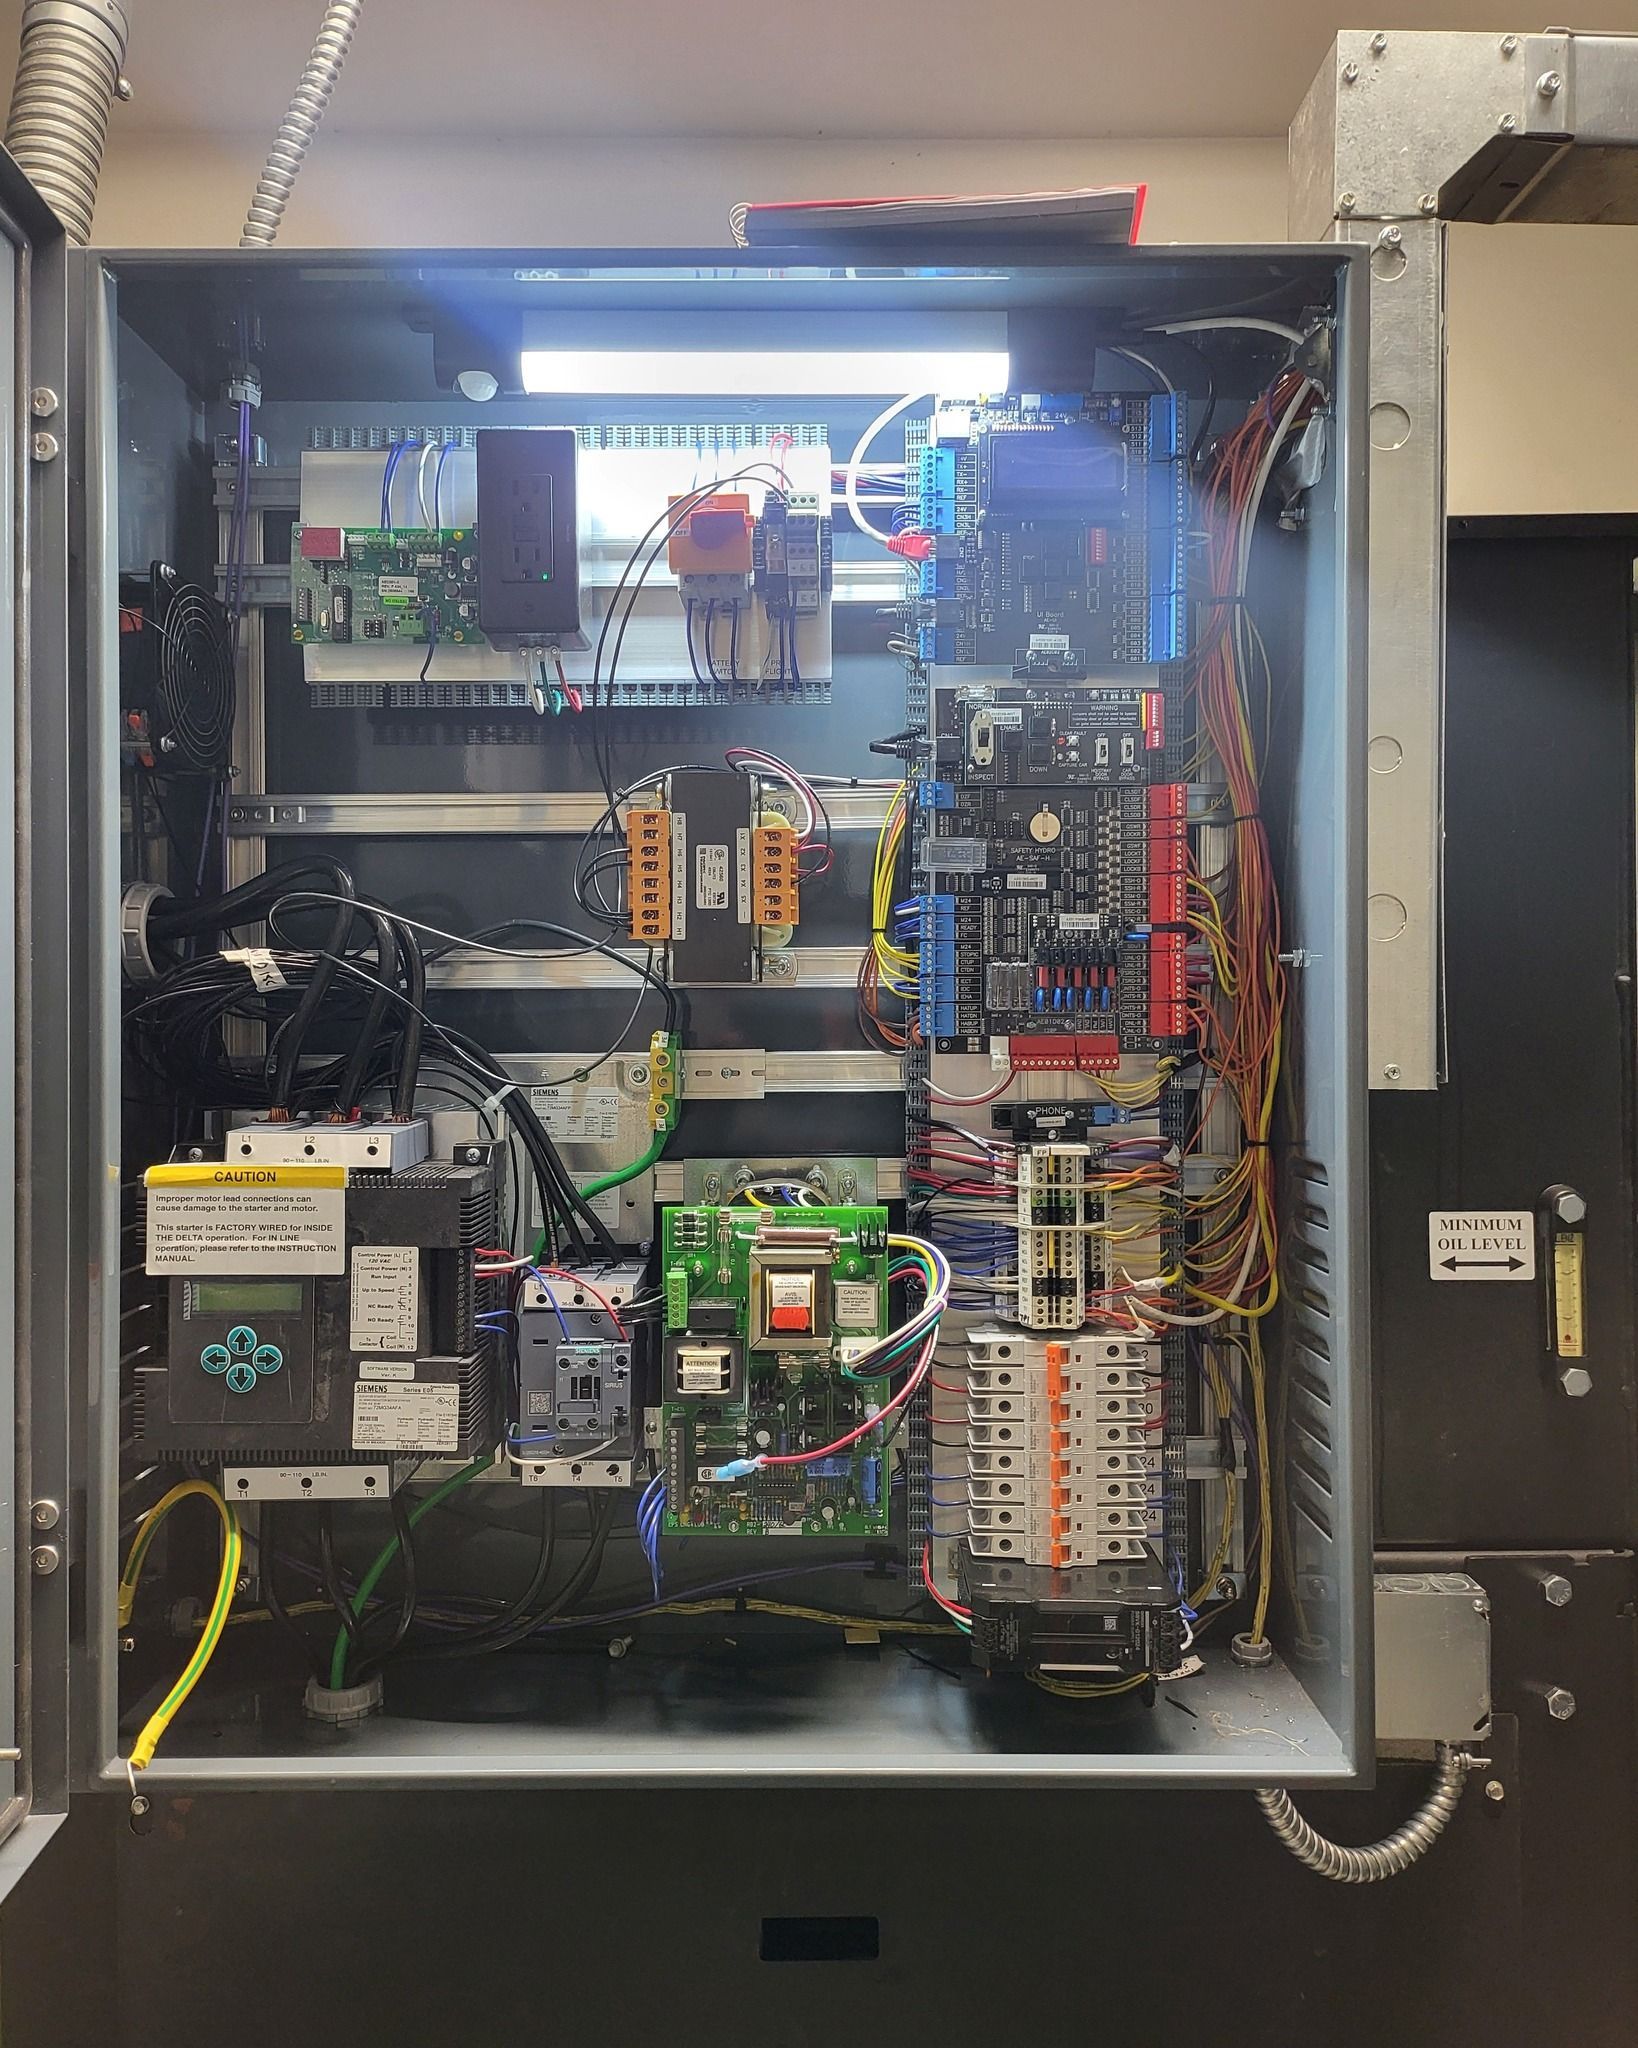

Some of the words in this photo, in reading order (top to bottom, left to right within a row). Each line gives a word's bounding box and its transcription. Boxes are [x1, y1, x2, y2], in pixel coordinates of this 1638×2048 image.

[677, 817, 682, 826] H8
[678, 833, 682, 841] H7
[740, 832, 745, 840] X1
[678, 848, 682, 857] H6
[740, 848, 745, 856] X2
[677, 864, 682, 873] H5
[741, 864, 746, 872] X3
[677, 880, 682, 888] H4
[677, 896, 682, 904] H3
[741, 895, 746, 904] X5
[677, 912, 682, 920] H2
[677, 927, 682, 935] H1
[1035, 1106, 1066, 1115] PHONE
[214, 1171, 276, 1182] CAUTION
[156, 1195, 194, 1203] Improper
[183, 1204, 216, 1213] damage
[1440, 1219, 1522, 1230] MINIMUM
[205, 1234, 248, 1242] operation.
[1438, 1238, 1467, 1250] OIL
[1472, 1238, 1526, 1250] LEVEL
[155, 1245, 197, 1253] operation,
[200, 1244, 227, 1252] please
[277, 1244, 337, 1252] INSTRUCTION
[357, 1384, 388, 1393] SIEMENS
[237, 1490, 248, 1498] T1
[364, 1488, 376, 1496] T3
